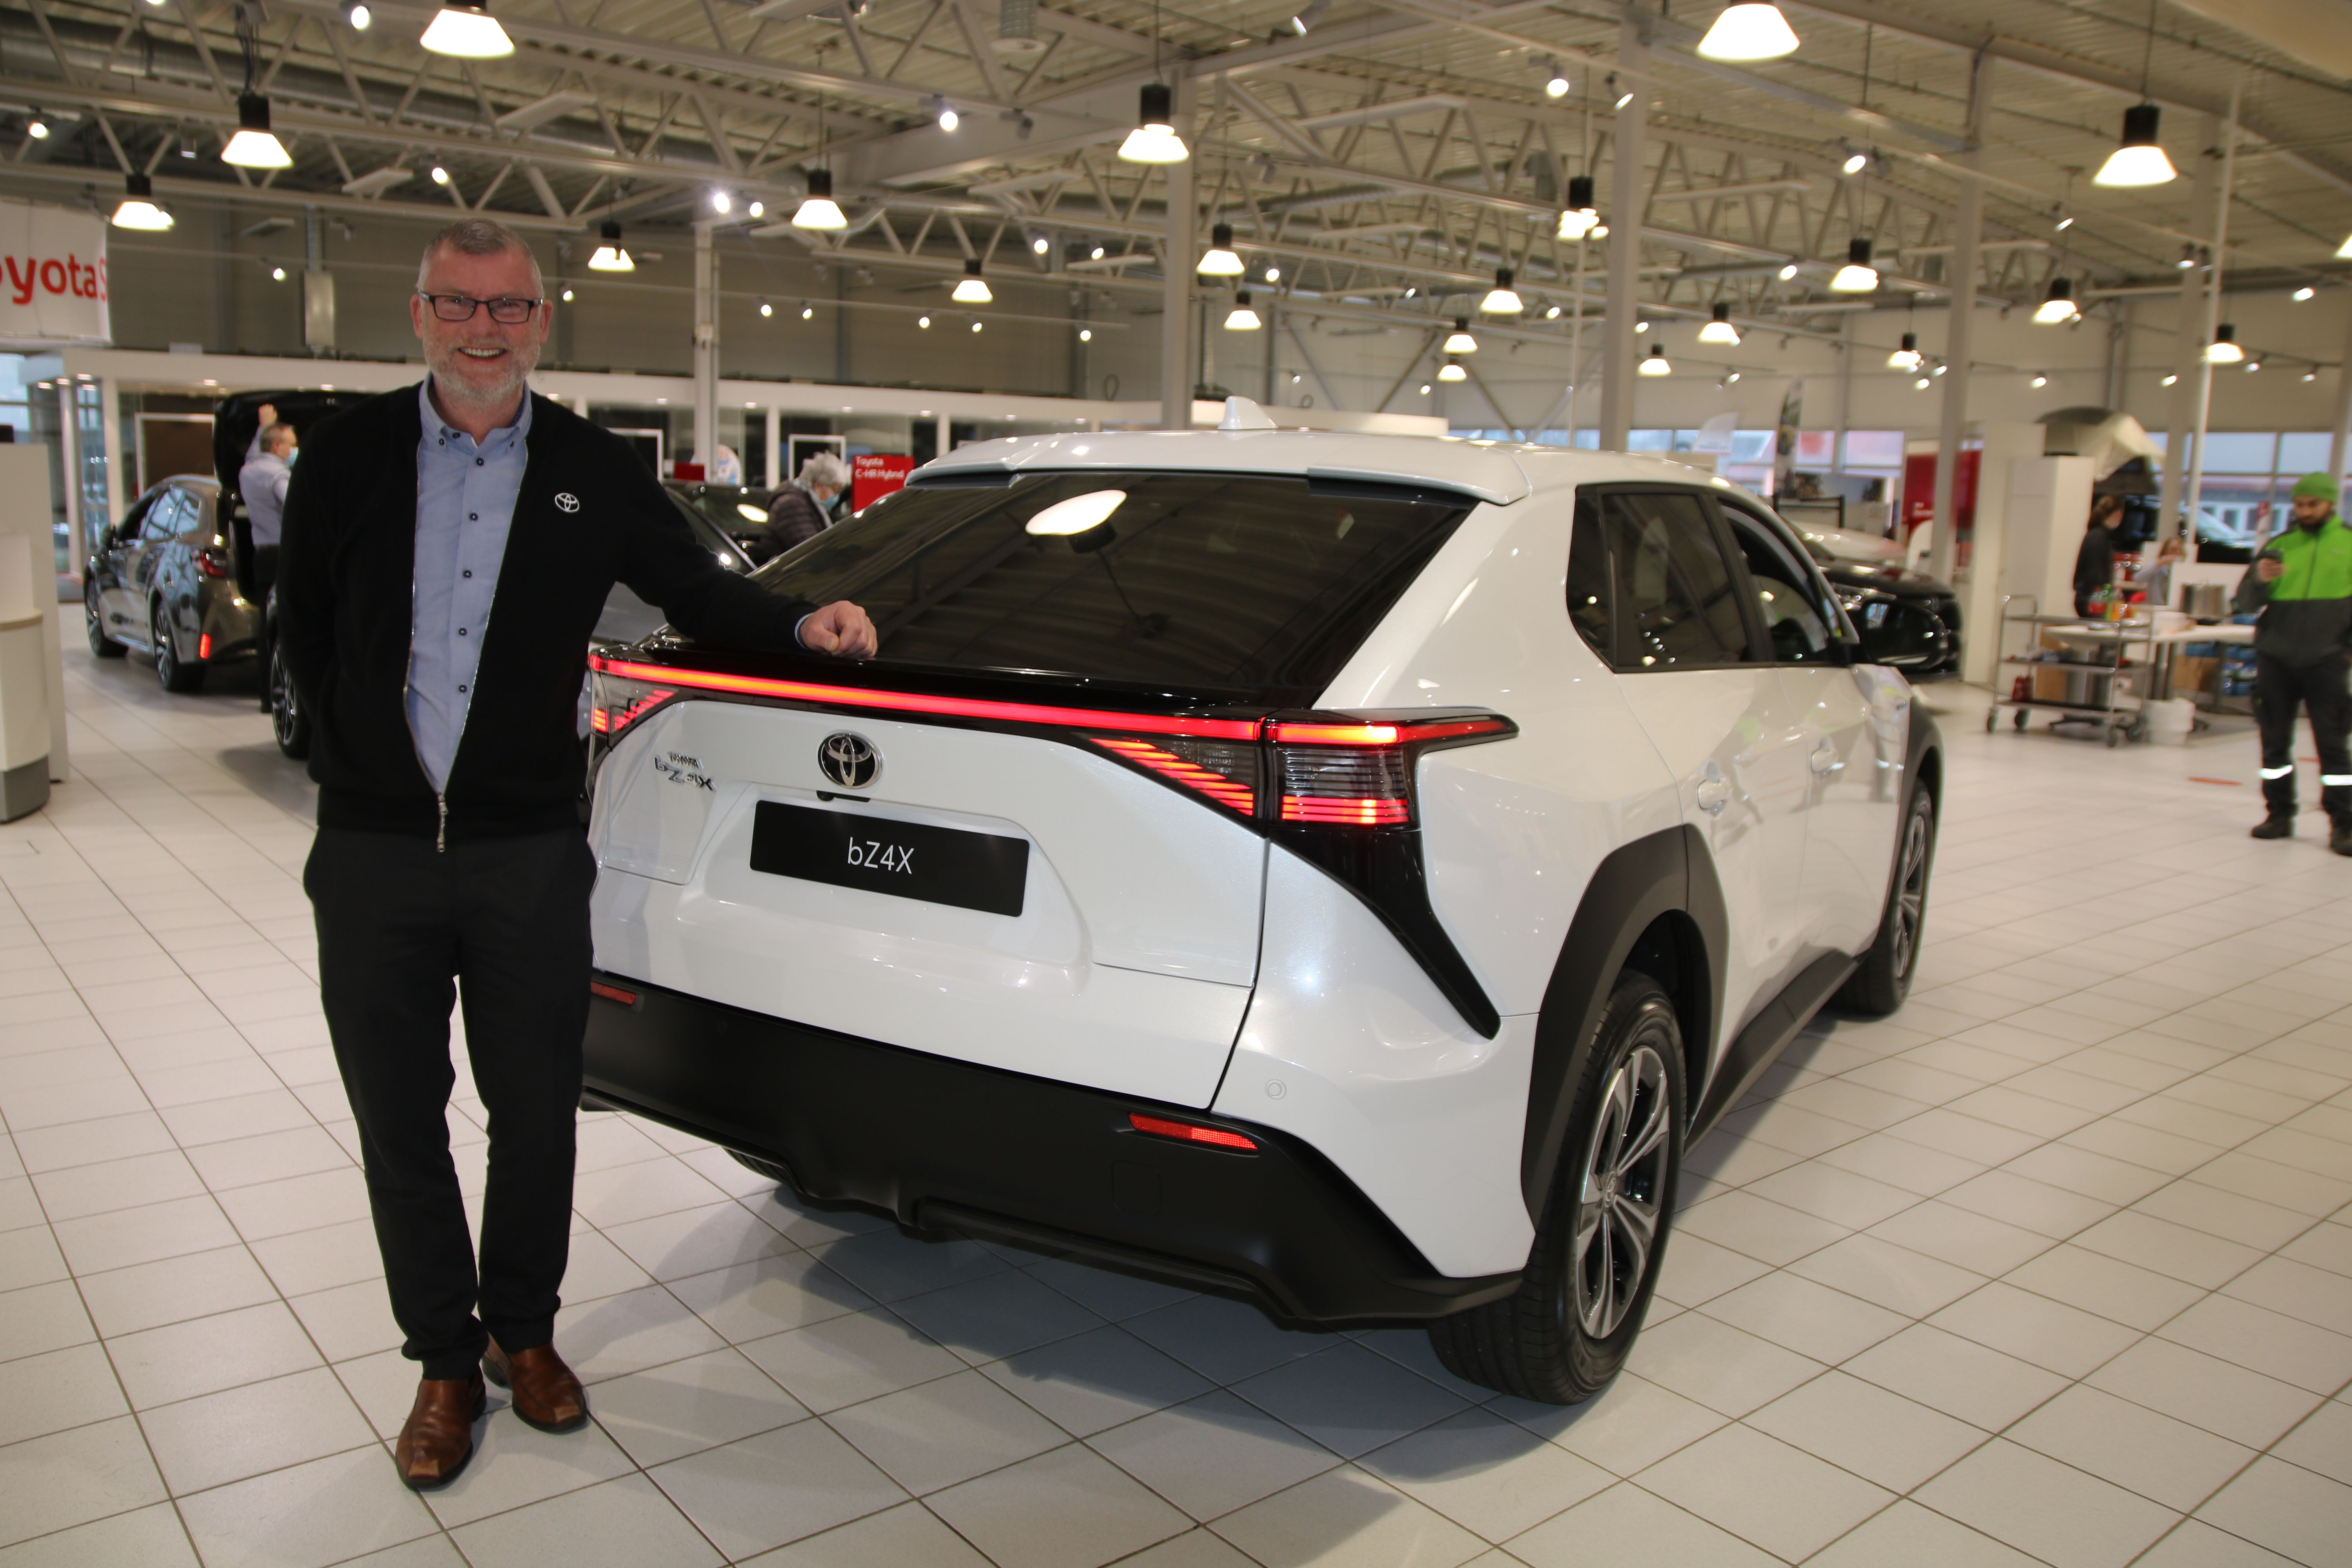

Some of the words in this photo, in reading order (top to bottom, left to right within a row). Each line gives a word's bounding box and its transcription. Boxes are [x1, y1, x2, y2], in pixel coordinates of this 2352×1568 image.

[856, 456, 884, 467] Toyota
[855, 468, 877, 479] C-HR
[667, 751, 703, 769] TOYOTA
[654, 755, 716, 792] bZ4X
[848, 837, 914, 874] bZ4X
